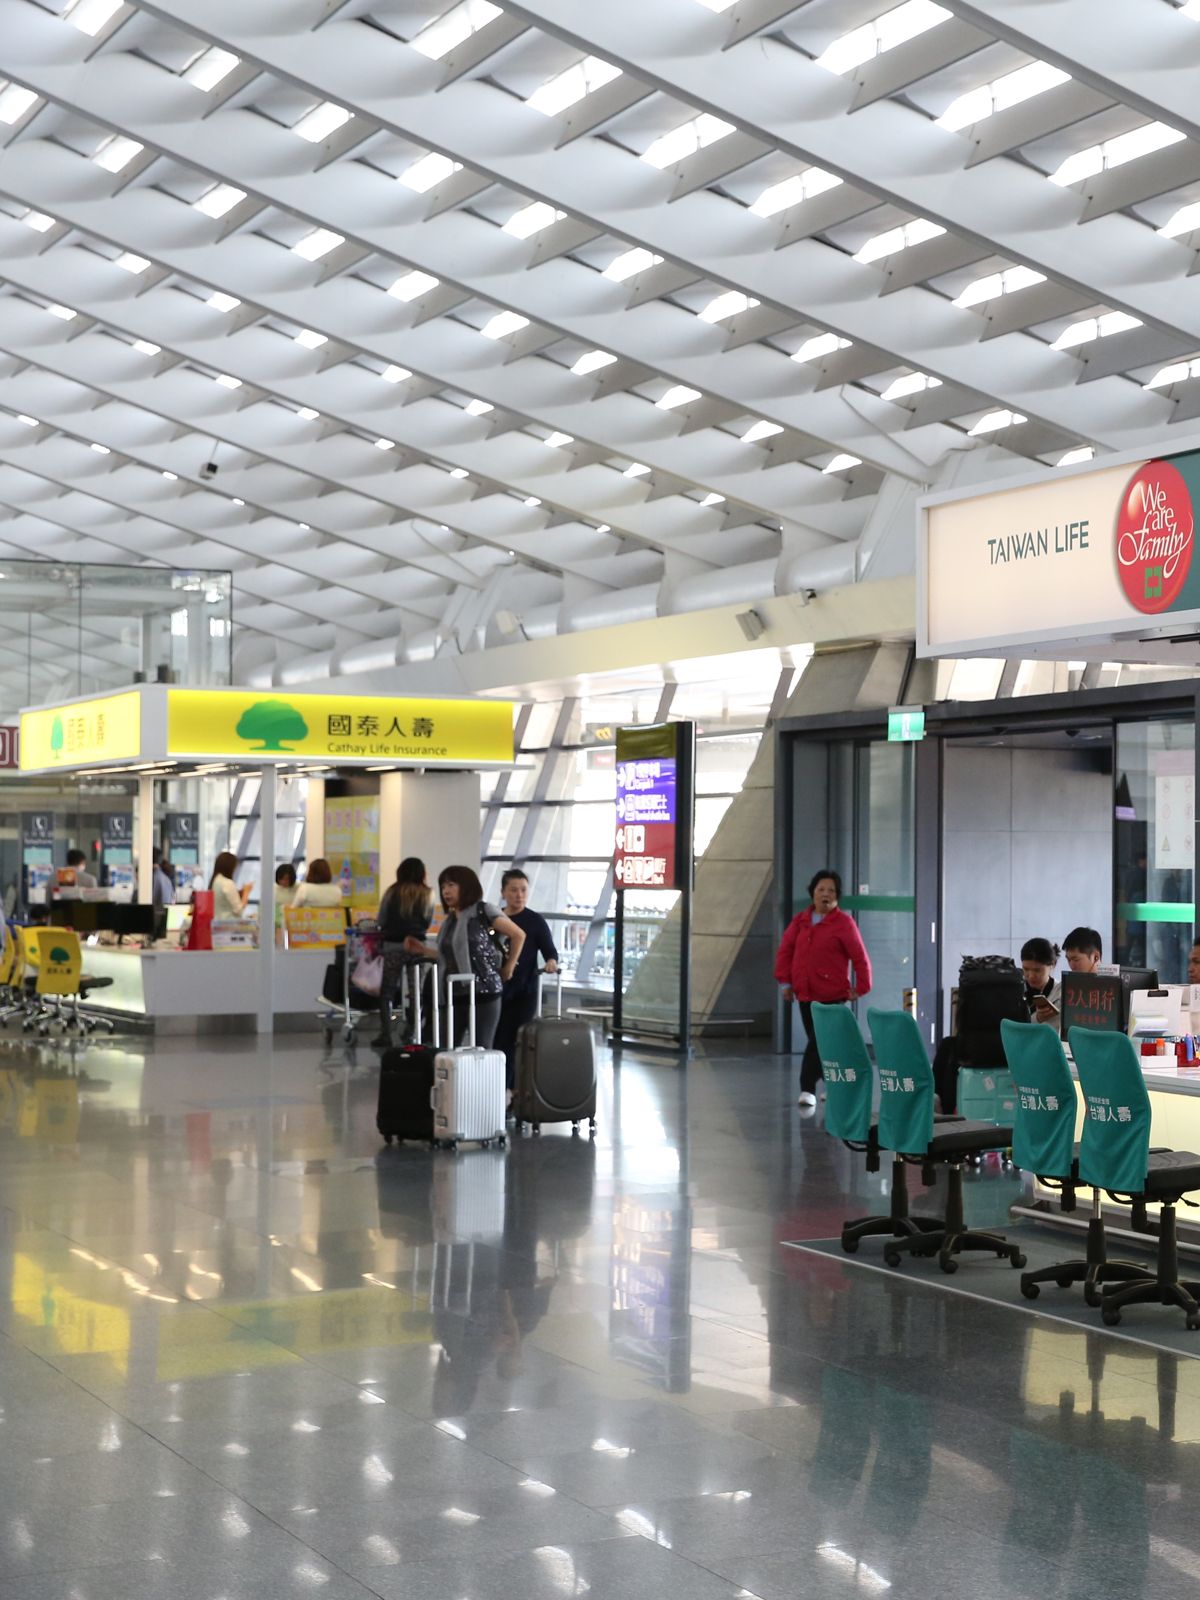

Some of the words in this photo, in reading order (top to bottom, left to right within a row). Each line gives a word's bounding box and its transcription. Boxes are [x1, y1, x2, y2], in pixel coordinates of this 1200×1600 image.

[1140, 480, 1167, 514] We
[1152, 506, 1174, 532] are
[987, 527, 1049, 565] TAIWAN
[1054, 520, 1090, 555] LIFE
[1118, 510, 1194, 578] Family
[328, 714, 435, 738] 國泰人壽
[327, 742, 367, 755] Cathay
[369, 743, 391, 754] Life
[393, 744, 448, 756] Insurance
